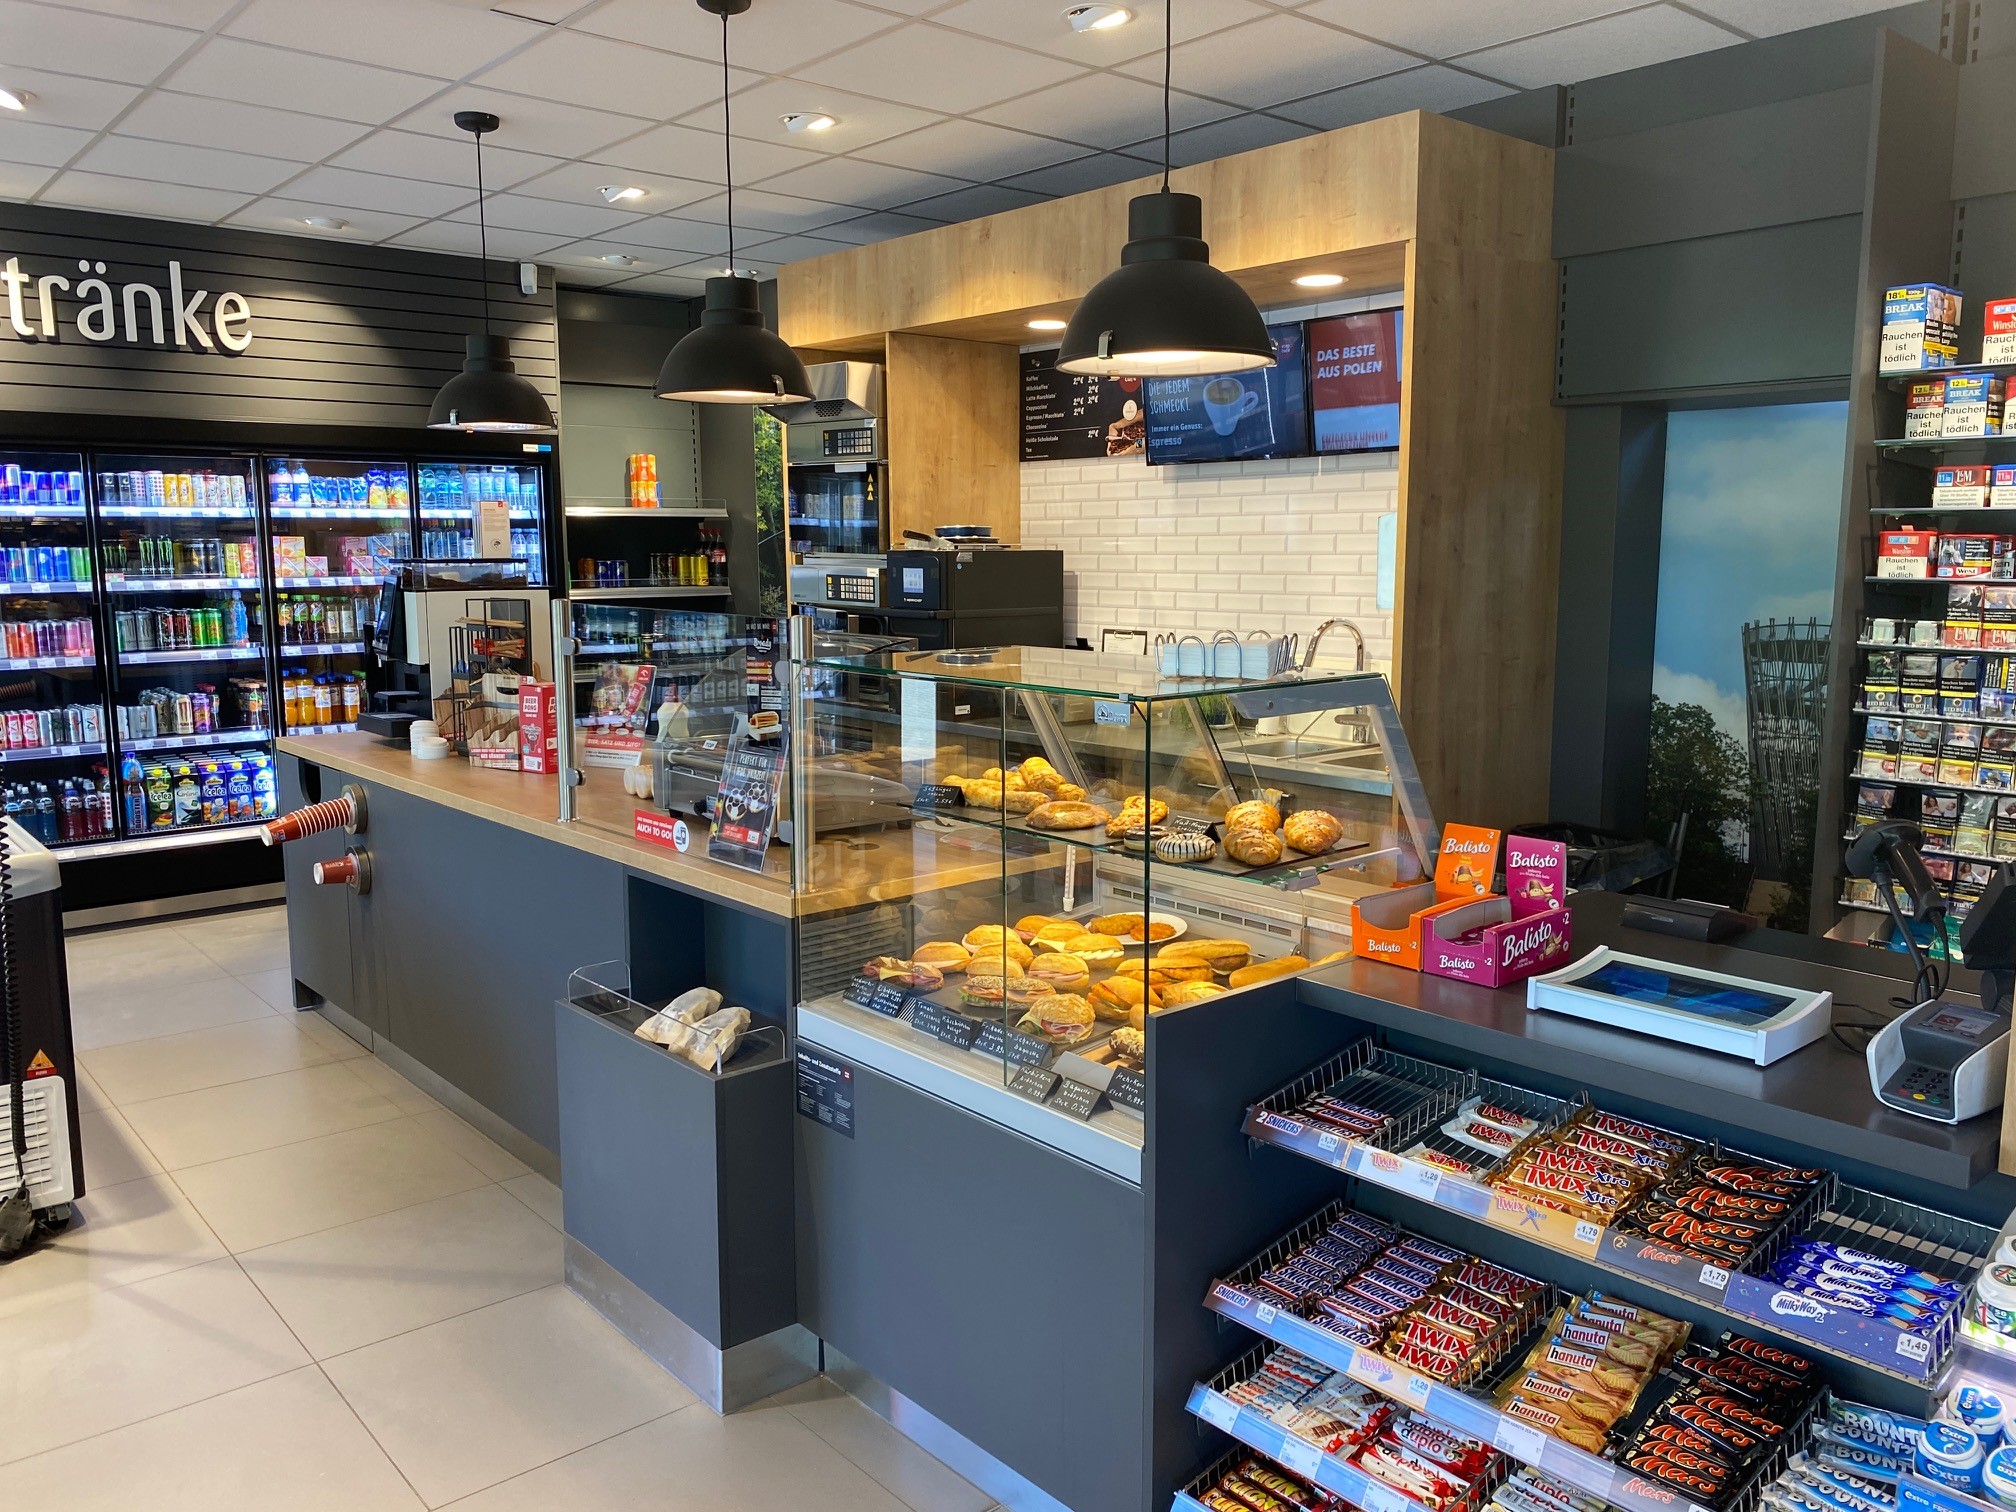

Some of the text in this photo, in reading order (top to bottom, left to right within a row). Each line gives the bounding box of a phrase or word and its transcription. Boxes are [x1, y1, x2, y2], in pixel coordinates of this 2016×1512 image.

[1885, 303, 1925, 314] BREAK
[1882, 331, 1923, 342] Rauchen
[1895, 343, 1907, 351] ist
[1317, 343, 1376, 362] DAS BESTE
[1884, 353, 1916, 363] tödlich
[2001, 345, 2014, 353] ist
[1317, 360, 1382, 379] AUS POLEN
[1149, 379, 1190, 397] DIE JEDEM
[1950, 388, 1982, 397] BREAK
[1150, 397, 1191, 415] SCHMECKT.
[1913, 395, 1943, 404] BREAK
[1943, 406, 1985, 414] Rauchen
[1151, 422, 1203, 433] Immer ein Genuss:
[1946, 425, 1979, 434] tödlich
[637, 822, 672, 841] AUCH TO GO!
[1443, 837, 1491, 855] Balisto
[1510, 851, 1558, 868] Balisto
[1367, 938, 1402, 954] Balisto
[1502, 922, 1552, 968] Balisto
[1439, 954, 1476, 971] Balisto
[1256, 1110, 1302, 1135] 2 SNICKERS
[1482, 1104, 1524, 1124] TWIX
[1471, 1123, 1514, 1144] TWIX
[1597, 1113, 1686, 1154] TWIX Xtra
[1577, 1129, 1669, 1169] TWIX Xtra
[1534, 1147, 1631, 1188] TWIX Xtra
[1523, 1164, 1620, 1206] TWIX Xtra
[1637, 1245, 1683, 1265] Mars
[1379, 1257, 1438, 1288] SNICKERS
[1457, 1262, 1526, 1304] TWIX
[1364, 1268, 1428, 1300] SNICKERS
[1215, 1286, 1251, 1308] SNICKERS
[1354, 1279, 1412, 1312] SNICKERS
[1446, 1284, 1515, 1326] TWIX
[1426, 1296, 1497, 1339] TWIX
[1312, 1315, 1380, 1347] SNICKERS
[1406, 1319, 1477, 1362] TWIX
[1563, 1325, 1606, 1346] hanuta
[1550, 1346, 1594, 1368] hanuta
[1728, 1337, 1809, 1371] Mars
[1525, 1377, 1571, 1399] hanuta
[1961, 1390, 1976, 1409] extra
[1510, 1401, 1557, 1423] hanuta
[1695, 1395, 1785, 1435] Mars
[1670, 1404, 1756, 1447] Mars
[1844, 1410, 1920, 1446] BOUNT
[1939, 1426, 1970, 1443] extra
[1401, 1427, 1442, 1454] duplo
[1640, 1440, 1727, 1477] Mars
[1836, 1445, 1914, 1474] BOUNT
[1631, 1455, 1717, 1493] Mars
[1817, 1463, 1896, 1505] BOUNT
[1926, 1463, 1972, 1483] extra
[1623, 1477, 1677, 1505] Mars
[1904, 1490, 1930, 1506] extra
